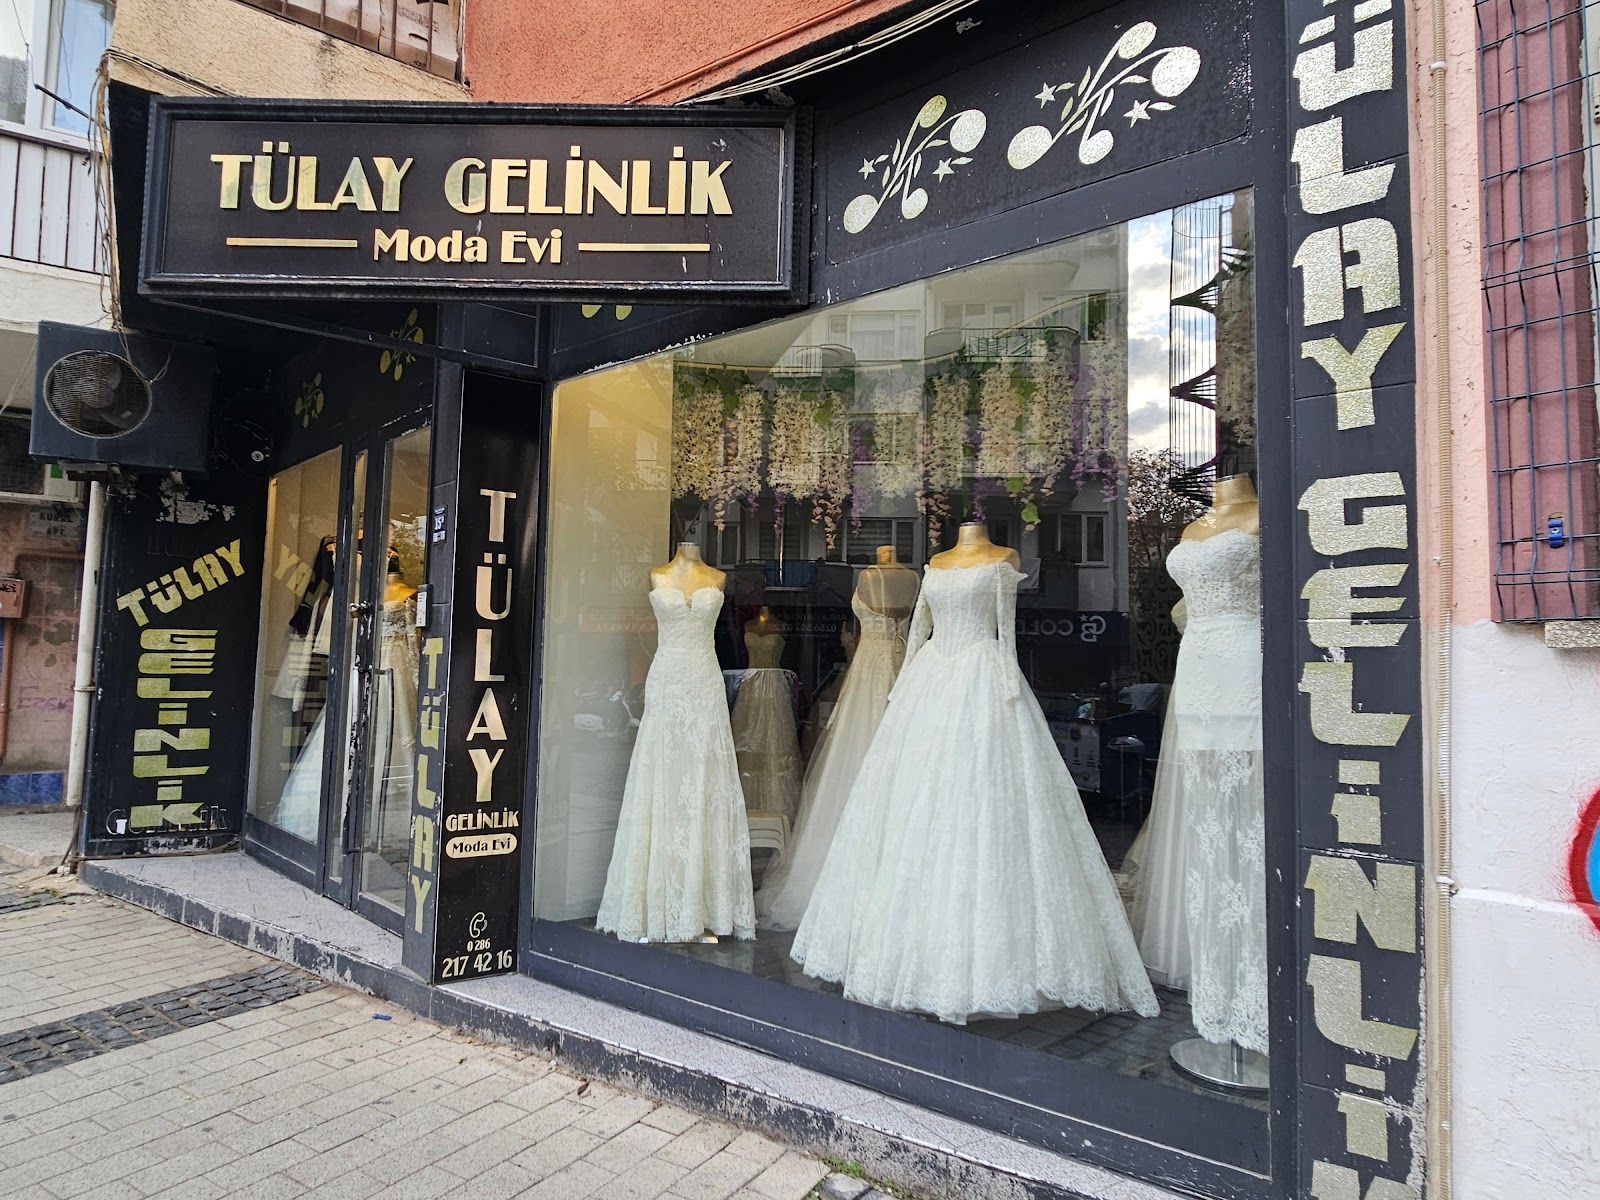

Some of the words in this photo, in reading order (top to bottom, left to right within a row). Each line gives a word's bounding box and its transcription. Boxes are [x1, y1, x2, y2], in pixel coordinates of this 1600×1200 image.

[210, 140, 414, 212] TÜLAY
[444, 145, 734, 216] GELİNLİK
[1292, 0, 1407, 431] ÜLAY
[373, 228, 488, 263] Moda
[500, 228, 563, 264] Evi
[116, 538, 245, 627] TÜLAY
[466, 488, 517, 802] TÜLAY
[130, 628, 218, 828] GELİNLİK
[411, 637, 444, 934] TÜLAY
[445, 806, 519, 832] GELİNLİK
[452, 841, 488, 854] Moda
[492, 837, 511, 851] Evi
[442, 955, 470, 978] 217
[473, 951, 493, 973] 42
[496, 949, 513, 970] 16
[466, 940, 474, 952] 0
[474, 938, 491, 951] 286
